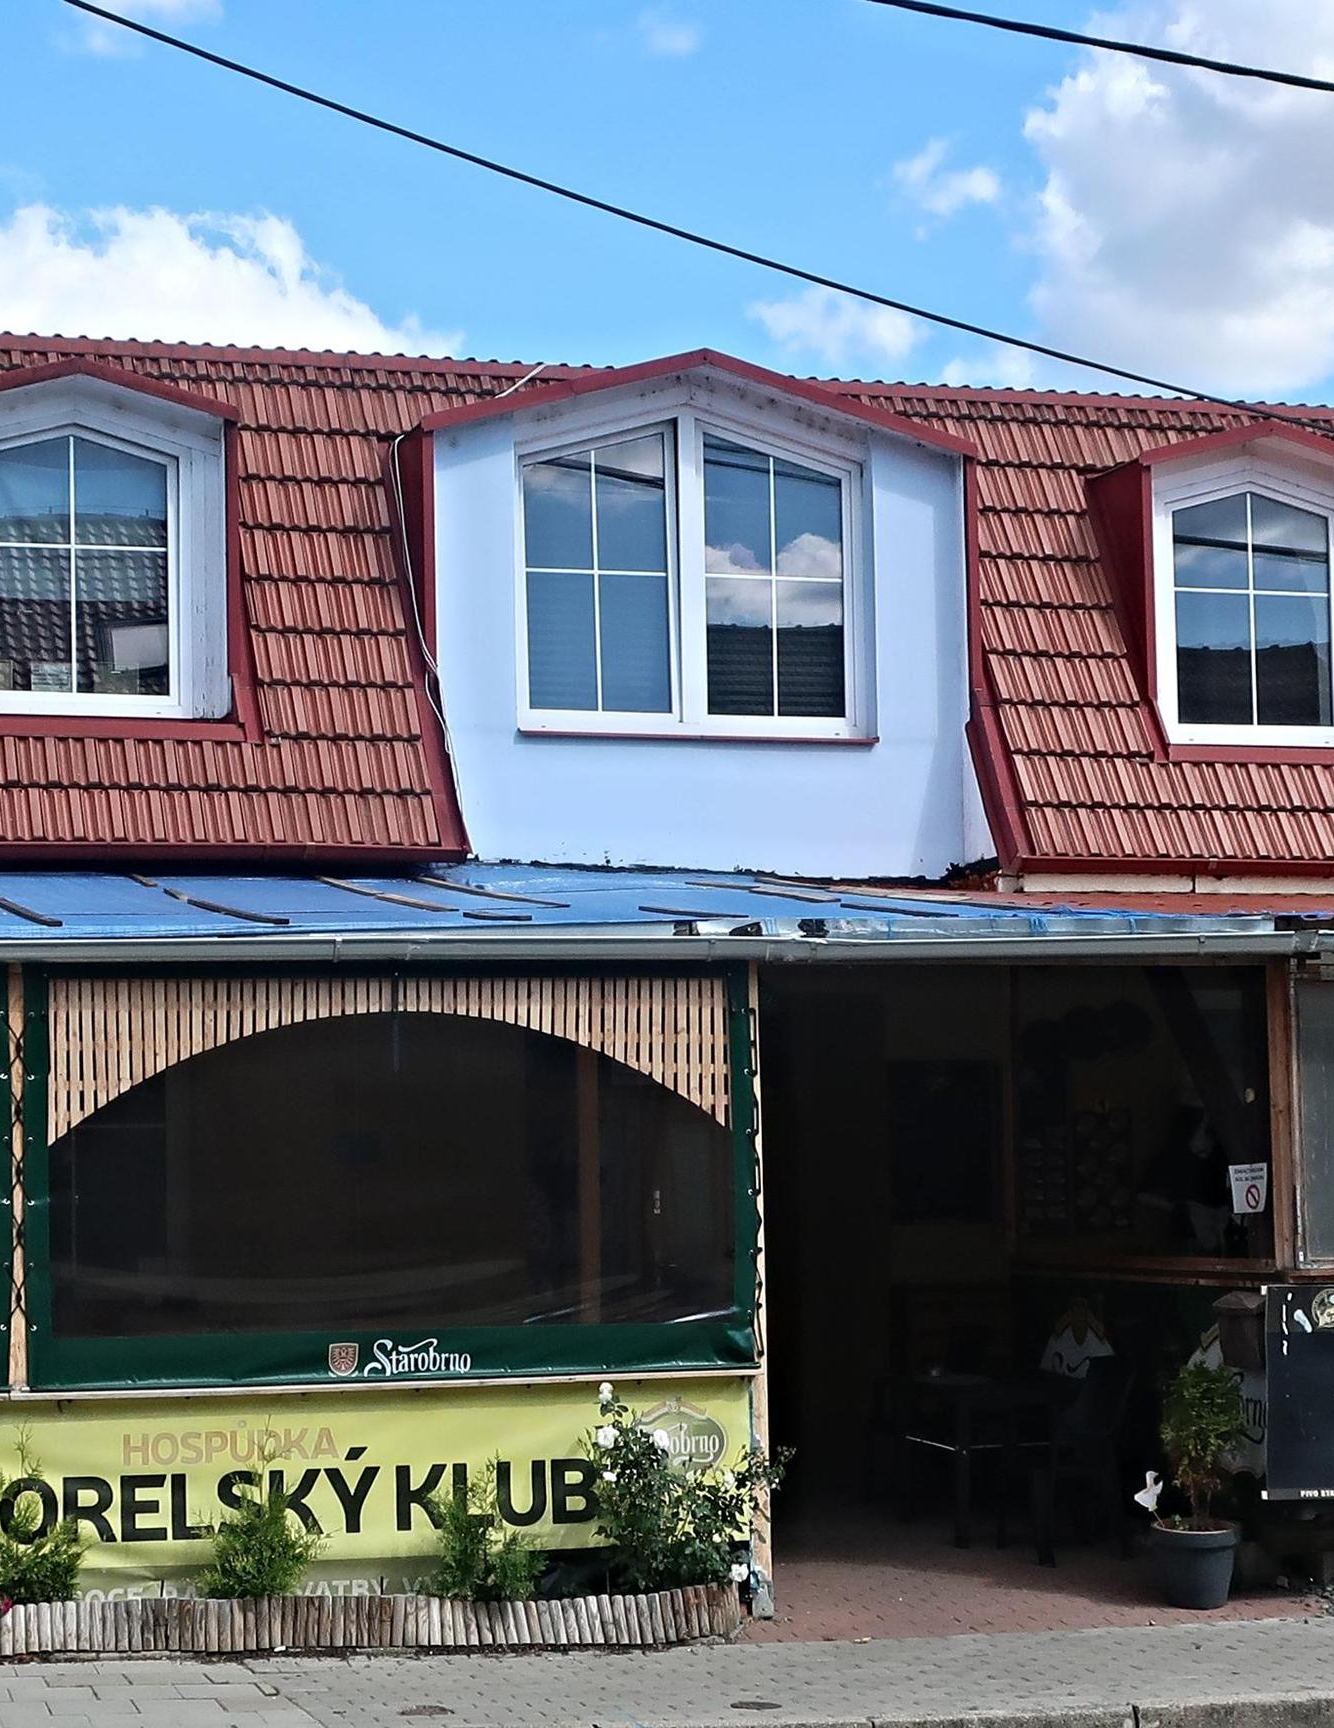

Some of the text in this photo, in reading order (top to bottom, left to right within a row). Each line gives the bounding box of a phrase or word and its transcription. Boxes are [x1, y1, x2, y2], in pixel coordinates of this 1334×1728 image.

[363, 1338, 471, 1377] Starobrno
[122, 1420, 339, 1466] HOSPŮDKA
[395, 1458, 600, 1533] KLUB
